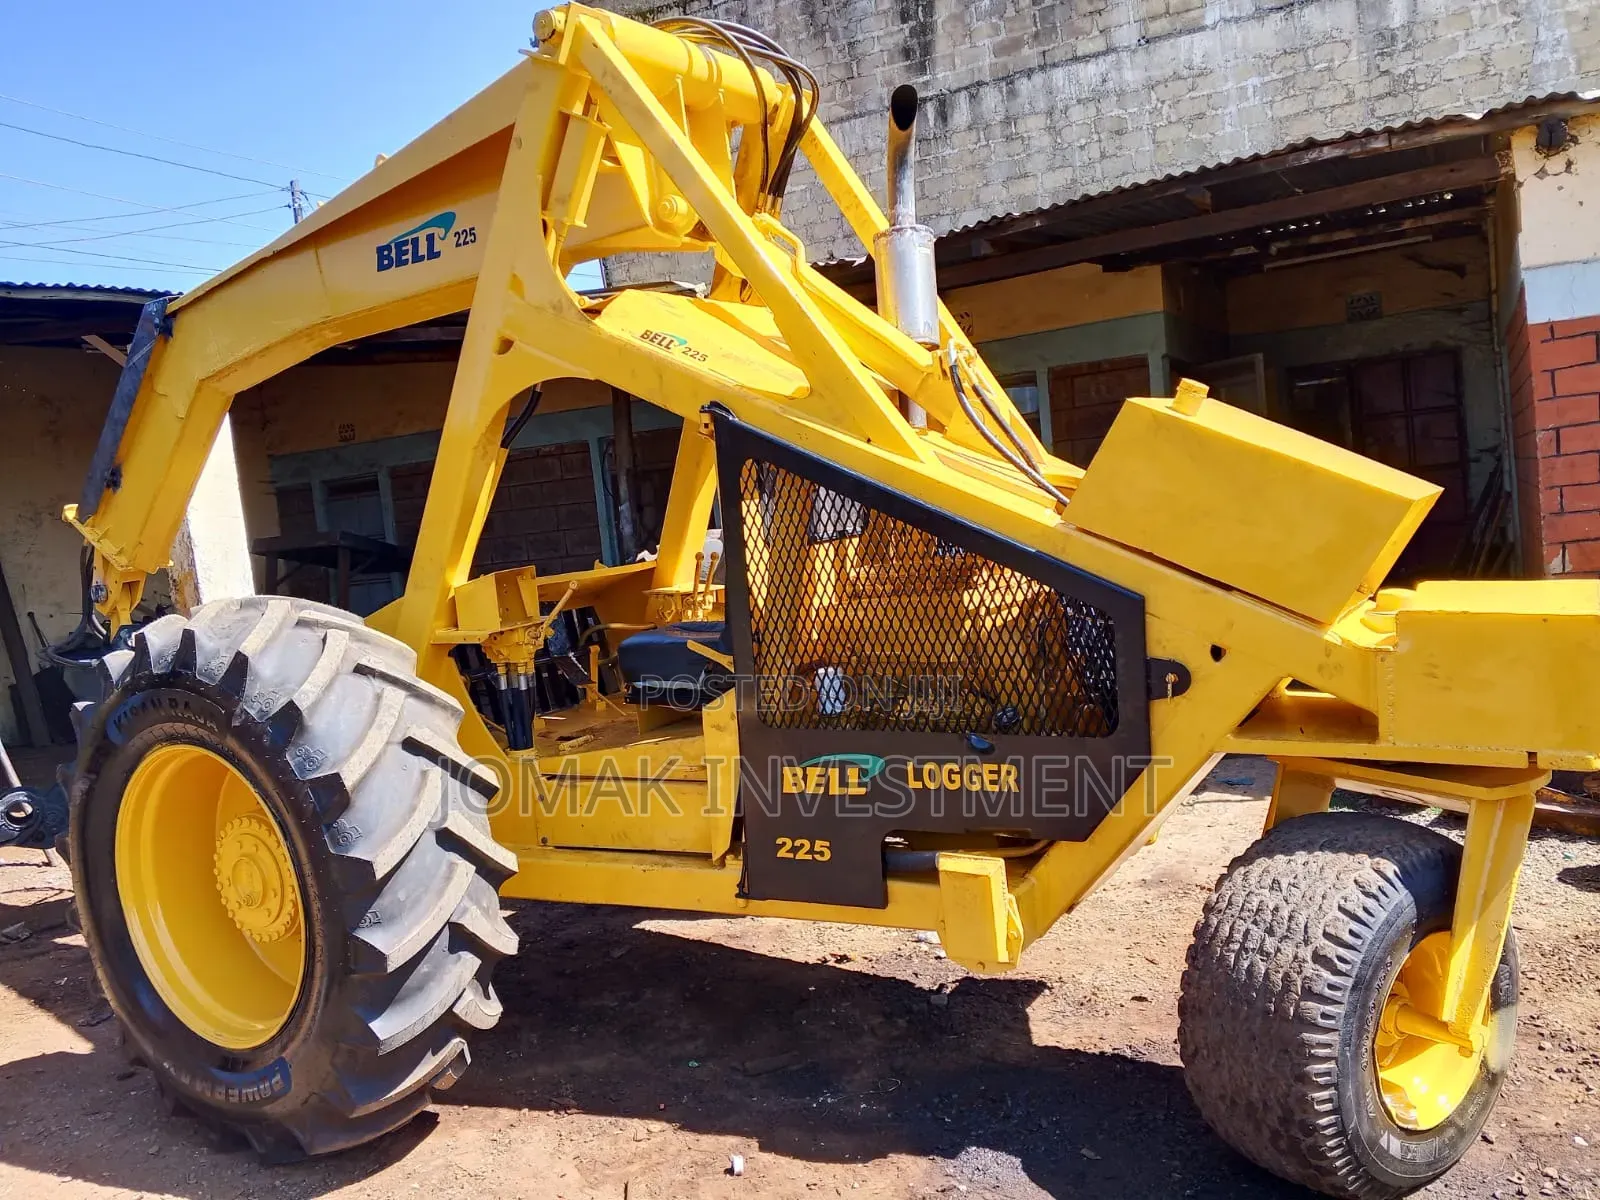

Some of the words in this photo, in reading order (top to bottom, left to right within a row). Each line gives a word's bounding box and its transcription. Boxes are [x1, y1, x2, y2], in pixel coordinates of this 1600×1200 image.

[376, 232, 442, 272] BELL
[453, 227, 477, 248] 225
[640, 329, 675, 350] BELL
[681, 346, 709, 362] 225
[782, 766, 868, 795] BELL
[906, 762, 1020, 793] LOGGER
[775, 837, 832, 863] 225
